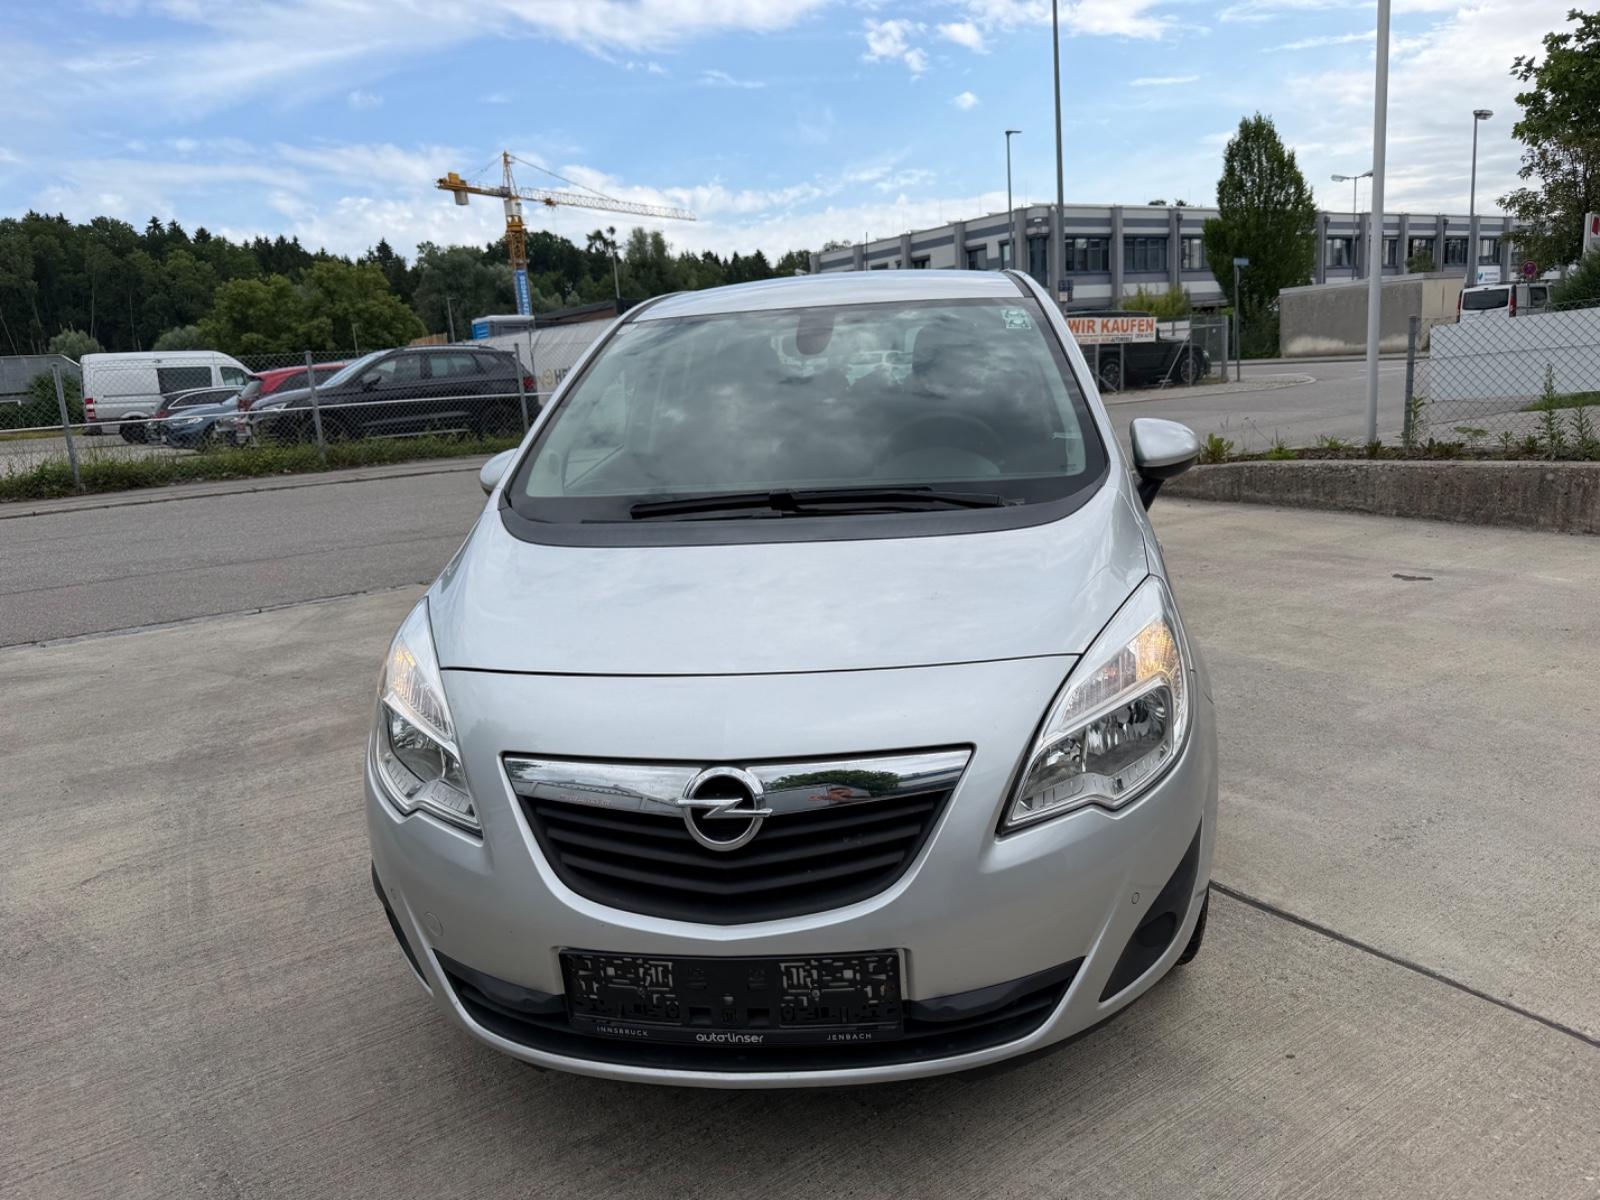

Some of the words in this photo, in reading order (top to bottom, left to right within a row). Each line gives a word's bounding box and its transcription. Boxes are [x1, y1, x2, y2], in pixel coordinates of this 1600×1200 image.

[1068, 319, 1096, 334] WIR
[1101, 319, 1154, 333] KAUFEN
[596, 1026, 649, 1037] INNSBRUCK
[826, 1032, 873, 1041] JENBACH
